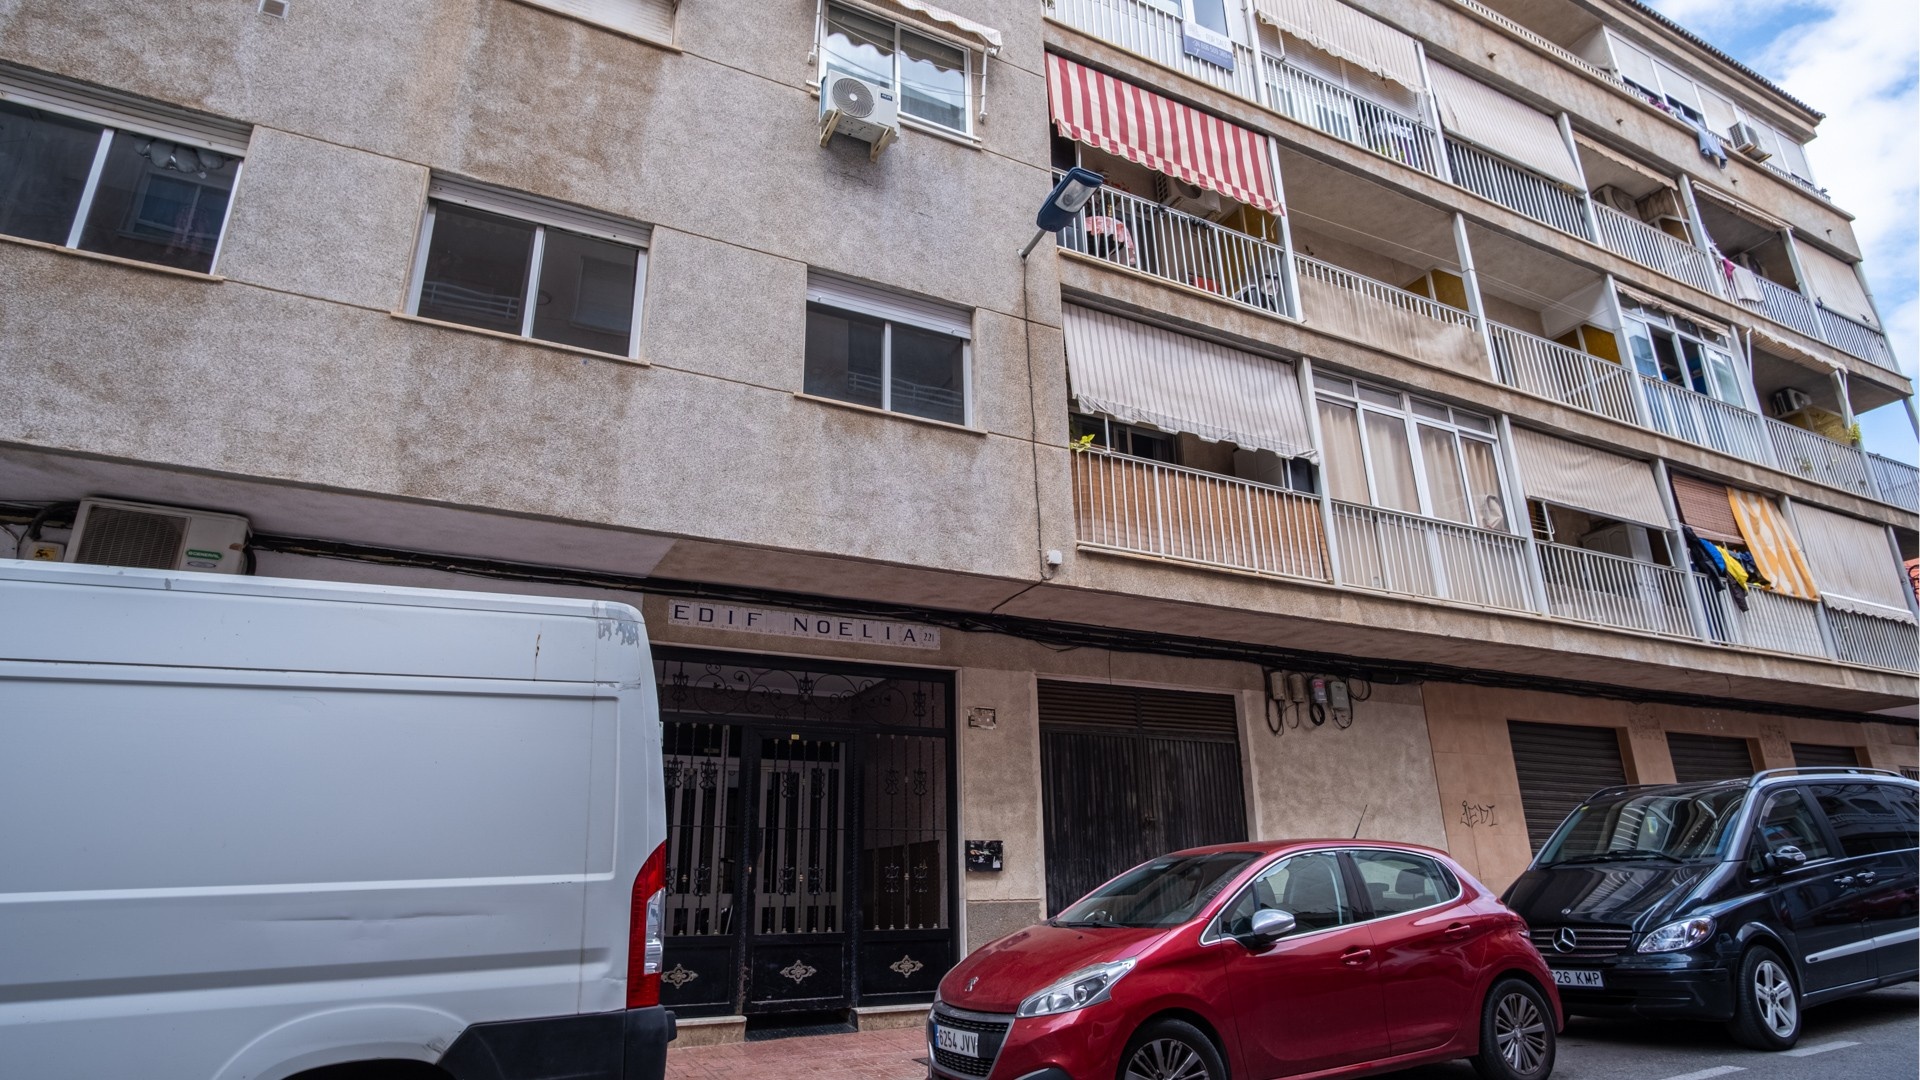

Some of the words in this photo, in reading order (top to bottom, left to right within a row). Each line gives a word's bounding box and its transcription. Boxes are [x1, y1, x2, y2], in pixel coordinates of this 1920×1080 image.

[674, 604, 763, 627] EDIF
[793, 617, 917, 643] NOELIA
[1460, 800, 1498, 828] JEDI
[1575, 971, 1600, 985] KMP
[939, 1029, 958, 1050] 6254
[960, 1034, 976, 1054] JVV
